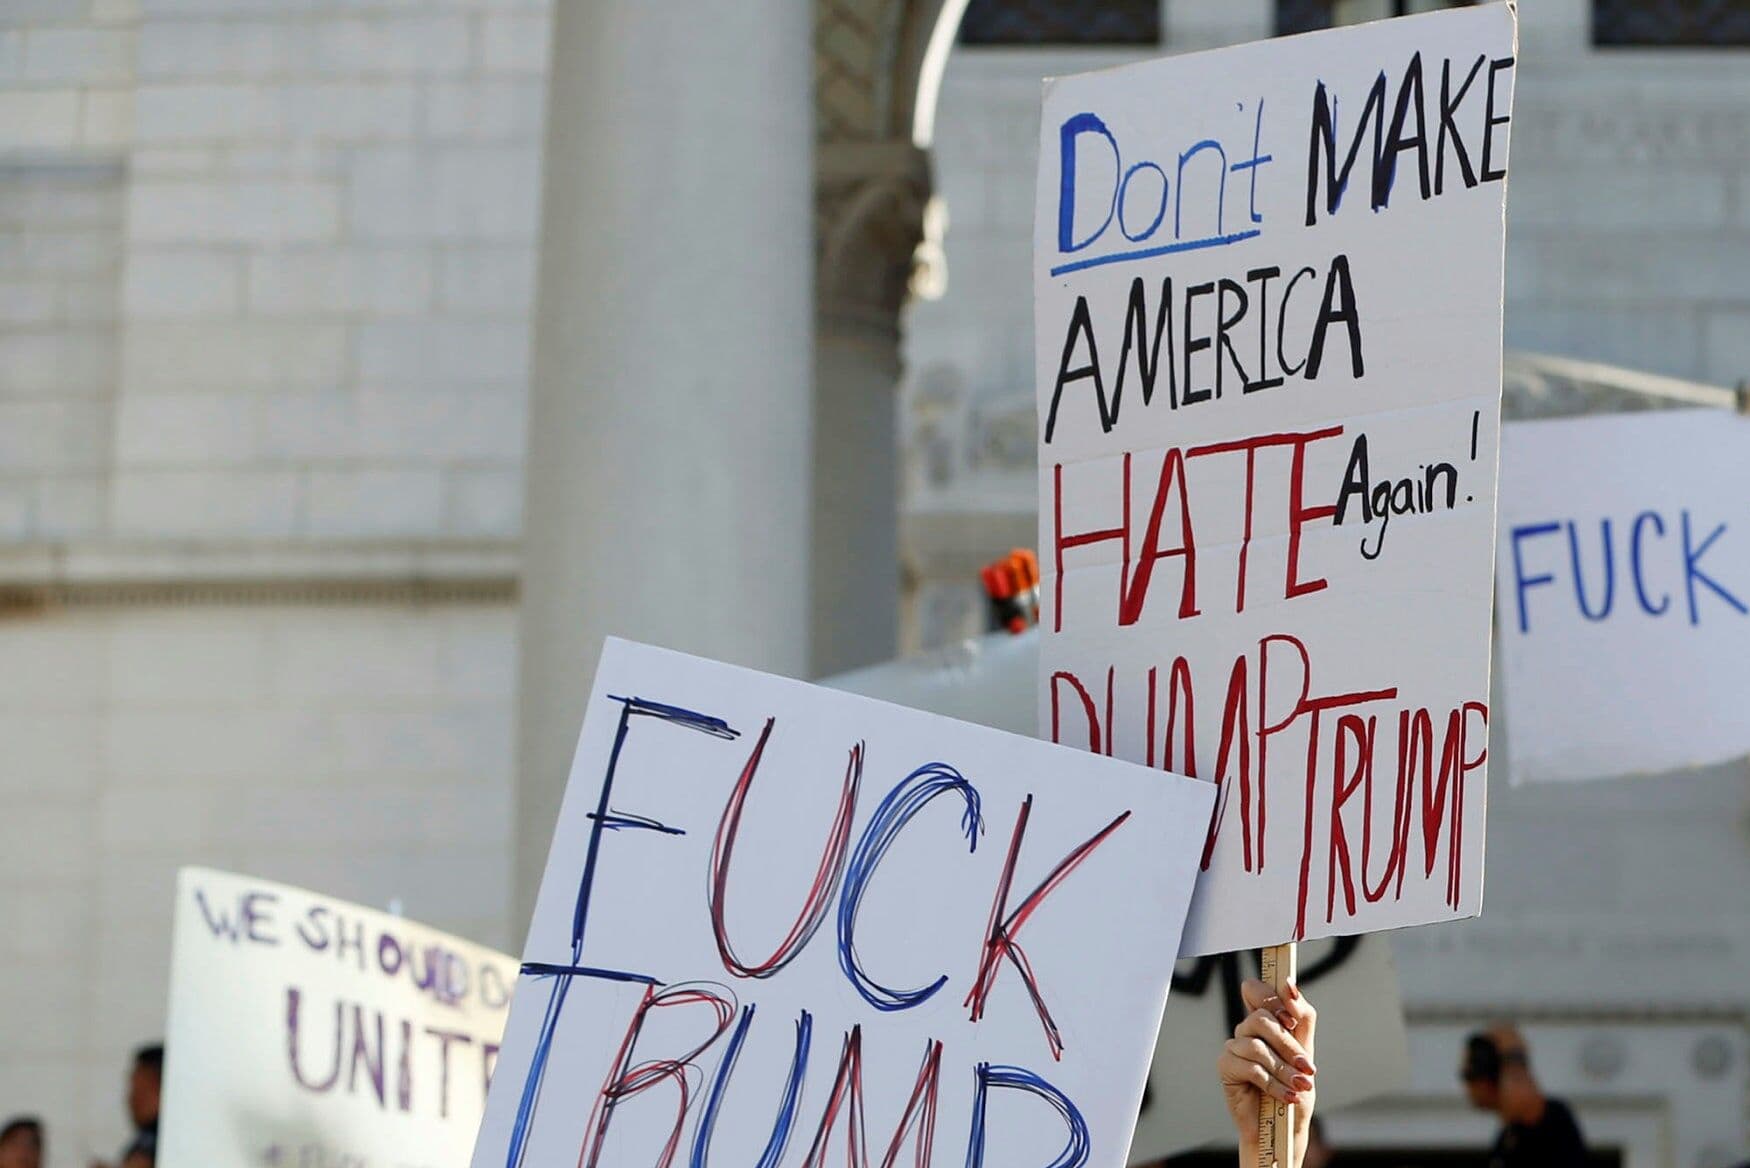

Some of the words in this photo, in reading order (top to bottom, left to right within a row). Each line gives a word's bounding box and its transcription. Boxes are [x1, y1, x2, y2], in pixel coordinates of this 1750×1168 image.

[1058, 97, 1272, 253] Don't
[1305, 50, 1515, 226] MAKE
[1044, 254, 1364, 443] AMERICA
[1054, 425, 1343, 633] HATE
[1333, 410, 1479, 560] Again!
[1511, 508, 1749, 634] FUCK
[571, 695, 1131, 1061] FUCK
[1293, 687, 1488, 941] TRUMP
[195, 886, 279, 946] WE
